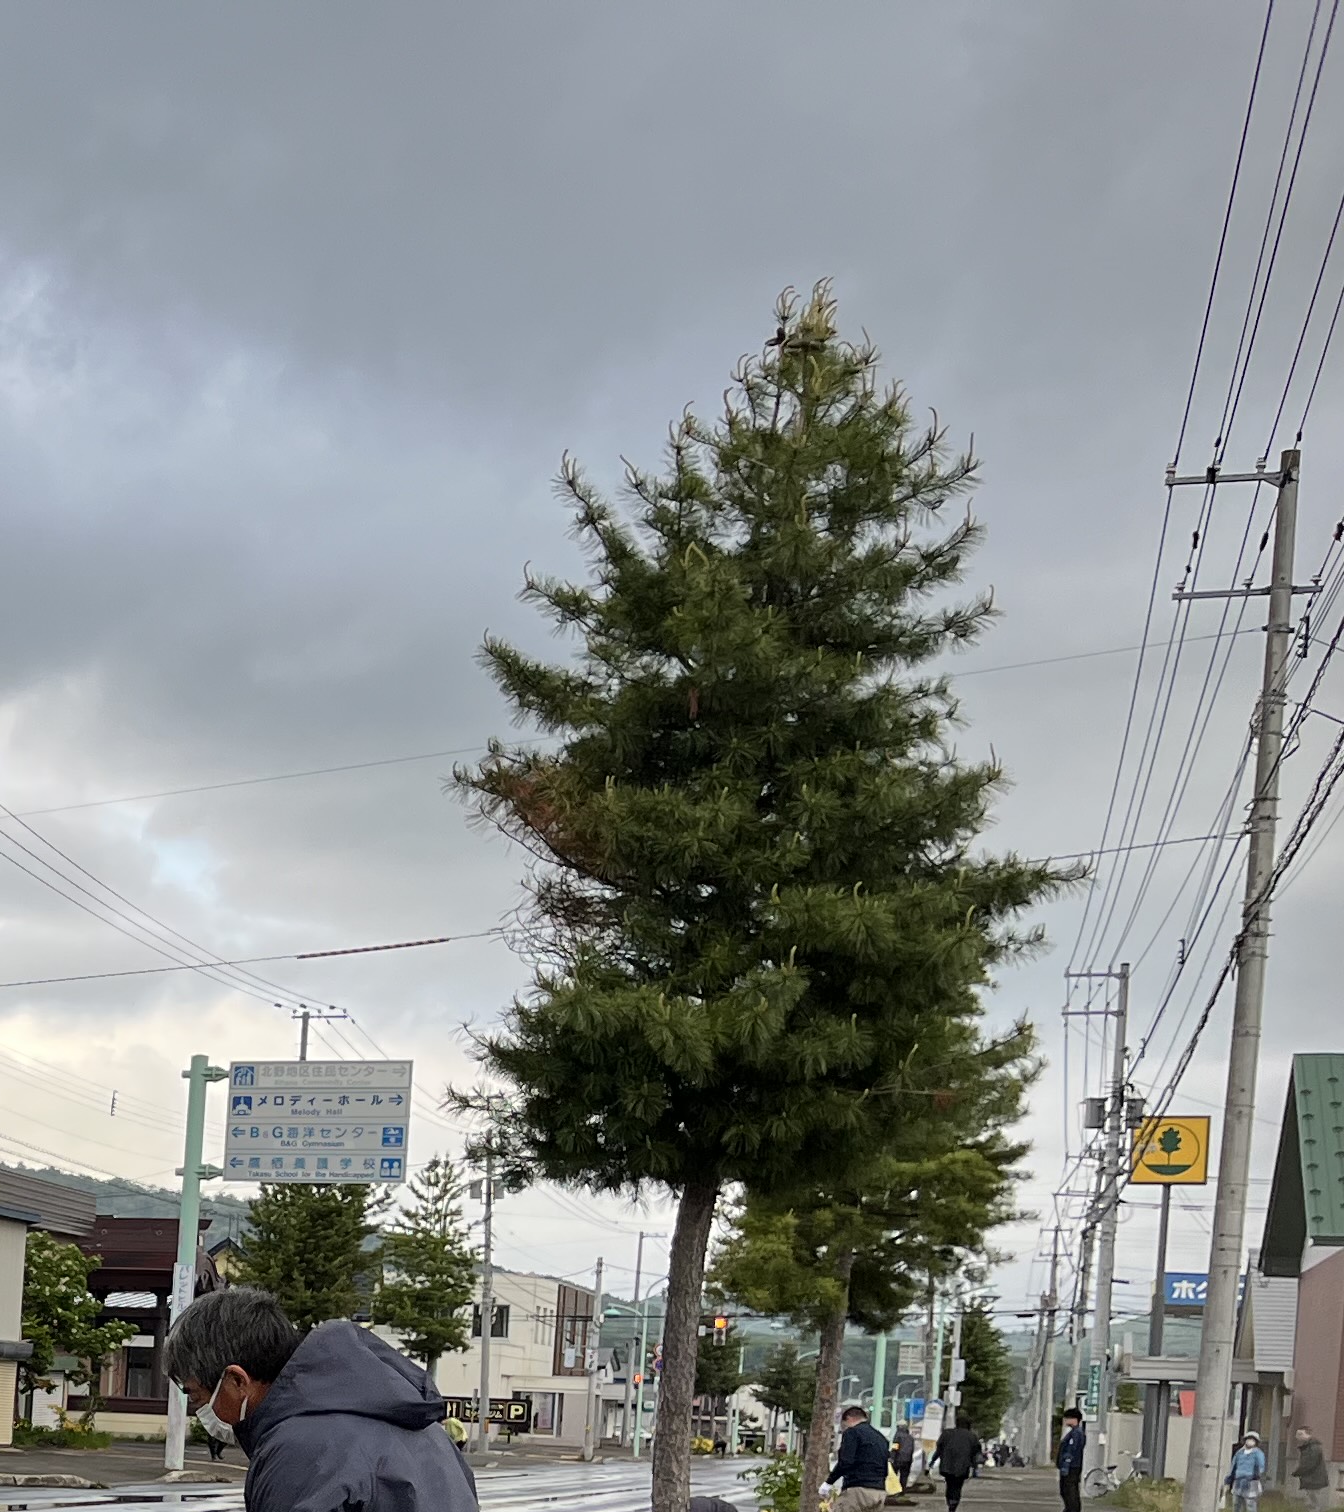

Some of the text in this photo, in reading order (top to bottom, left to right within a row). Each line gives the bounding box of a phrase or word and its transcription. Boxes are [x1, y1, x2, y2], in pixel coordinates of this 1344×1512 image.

[261, 1065, 389, 1078] 北野地区住民センター
[257, 1095, 383, 1106] メロディーホール
[302, 1140, 345, 1148] Gymnasium
[329, 1171, 375, 1179] Handicapped
[510, 1405, 524, 1419] P
